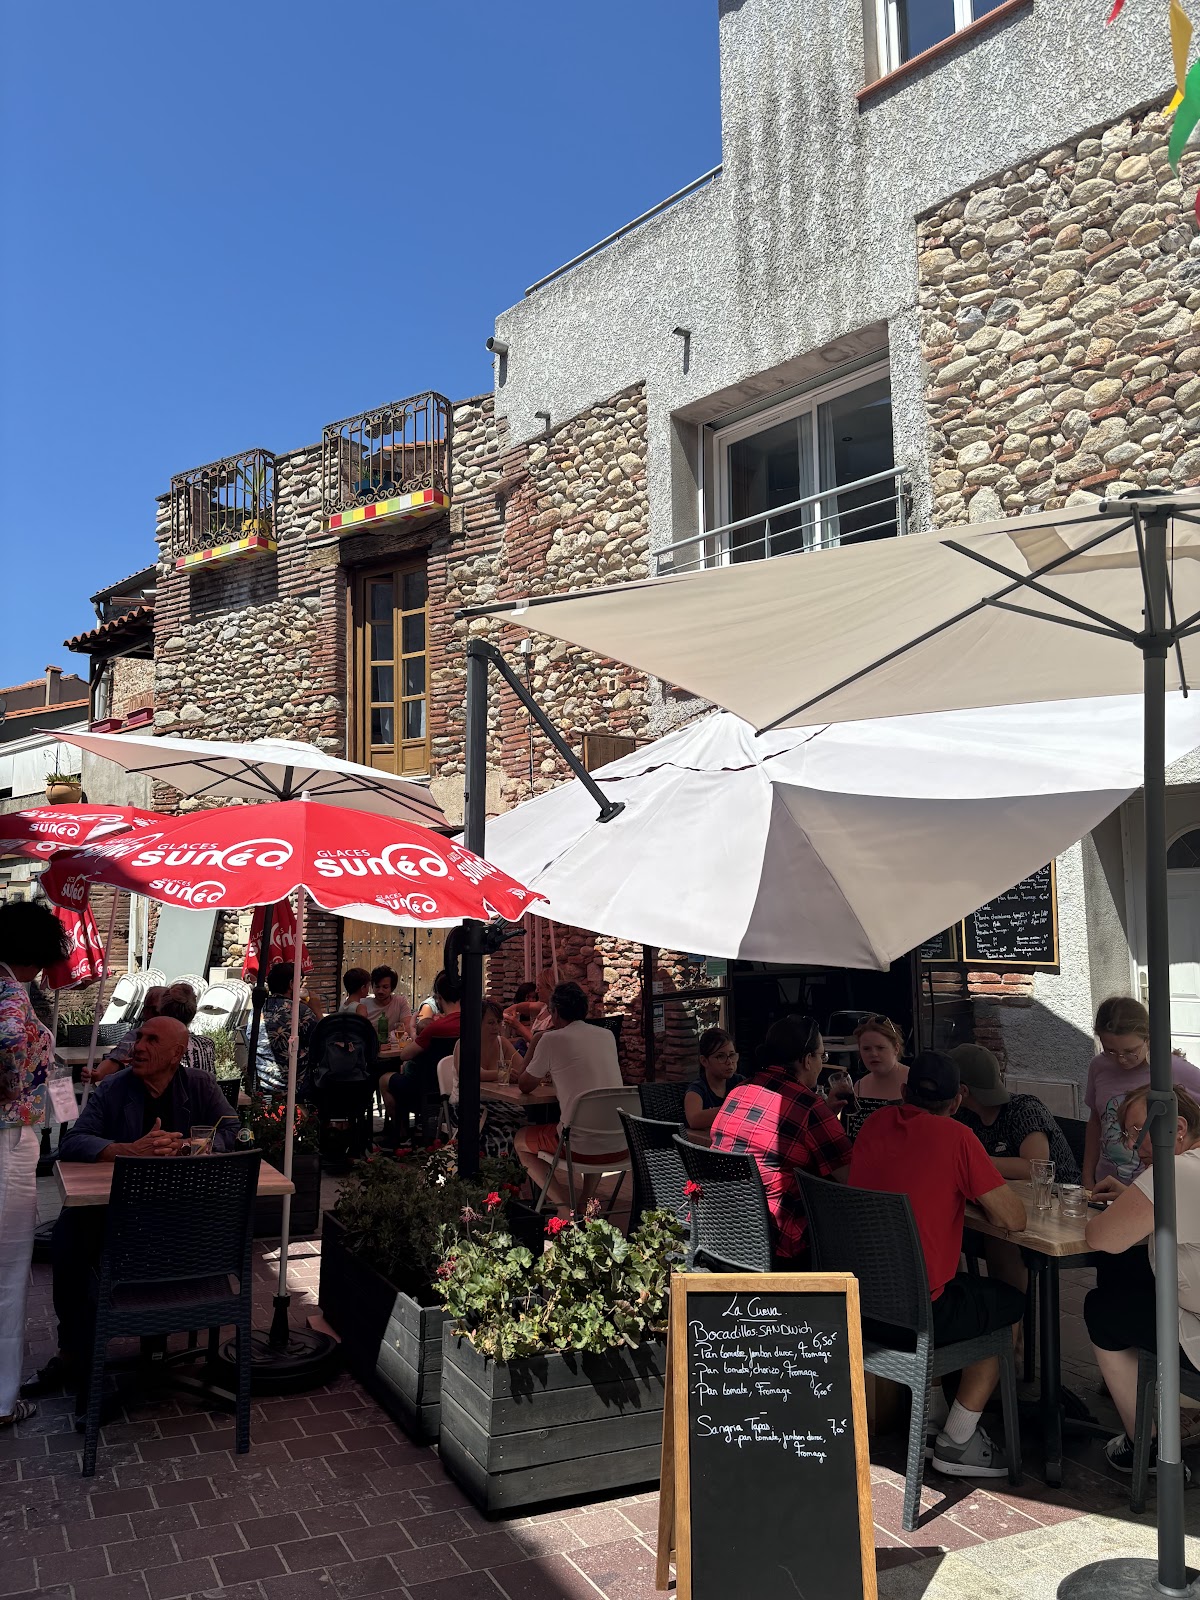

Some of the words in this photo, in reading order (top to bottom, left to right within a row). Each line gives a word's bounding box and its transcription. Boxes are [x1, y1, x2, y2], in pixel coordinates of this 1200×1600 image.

[316, 849, 371, 858] GLACES
[722, 1293, 743, 1317] La
[798, 1341, 832, 1364] Fromage
[783, 1360, 819, 1389] Fromage
[754, 1381, 792, 1403] Fromage
[697, 1415, 743, 1444] Sangria
[793, 1440, 828, 1464] Fromage
